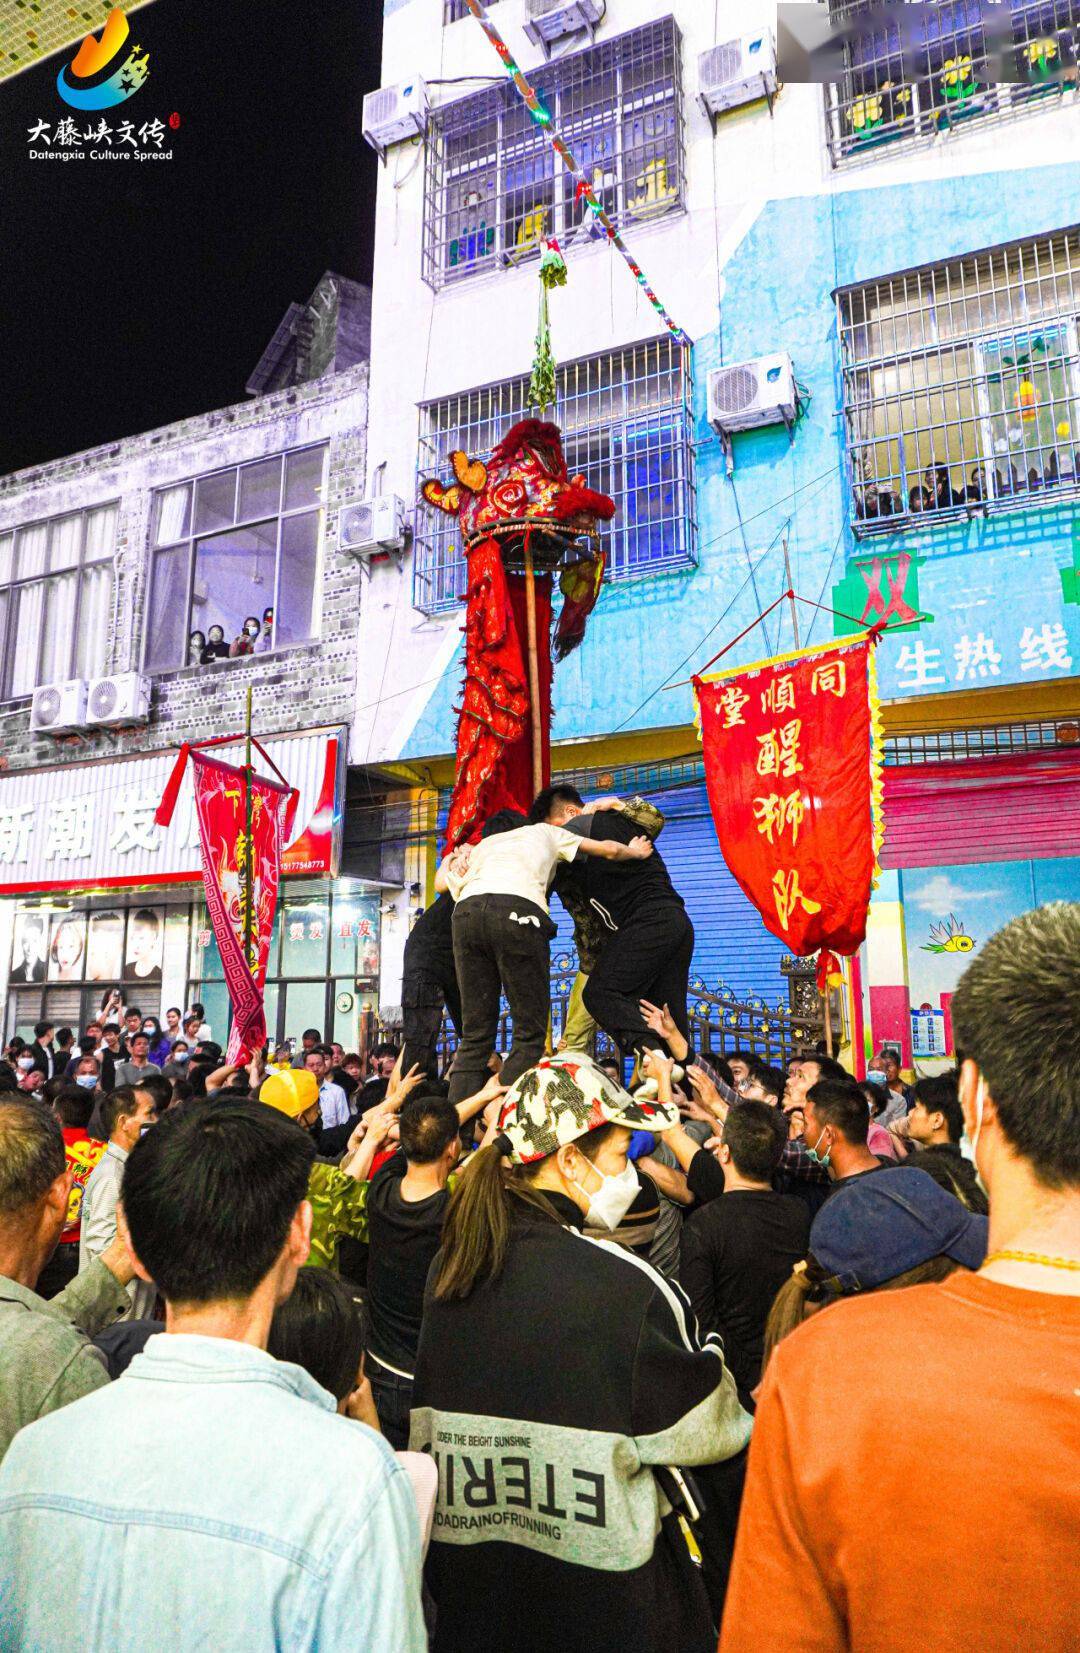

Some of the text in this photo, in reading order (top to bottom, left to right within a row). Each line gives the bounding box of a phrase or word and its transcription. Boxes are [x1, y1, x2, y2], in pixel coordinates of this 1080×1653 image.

[855, 552, 920, 625] 双
[894, 622, 1073, 689] 生热线
[0, 792, 200, 865] 新潮发
[453, 1433, 467, 1447] THE
[494, 1435, 532, 1448] SUNSHINE
